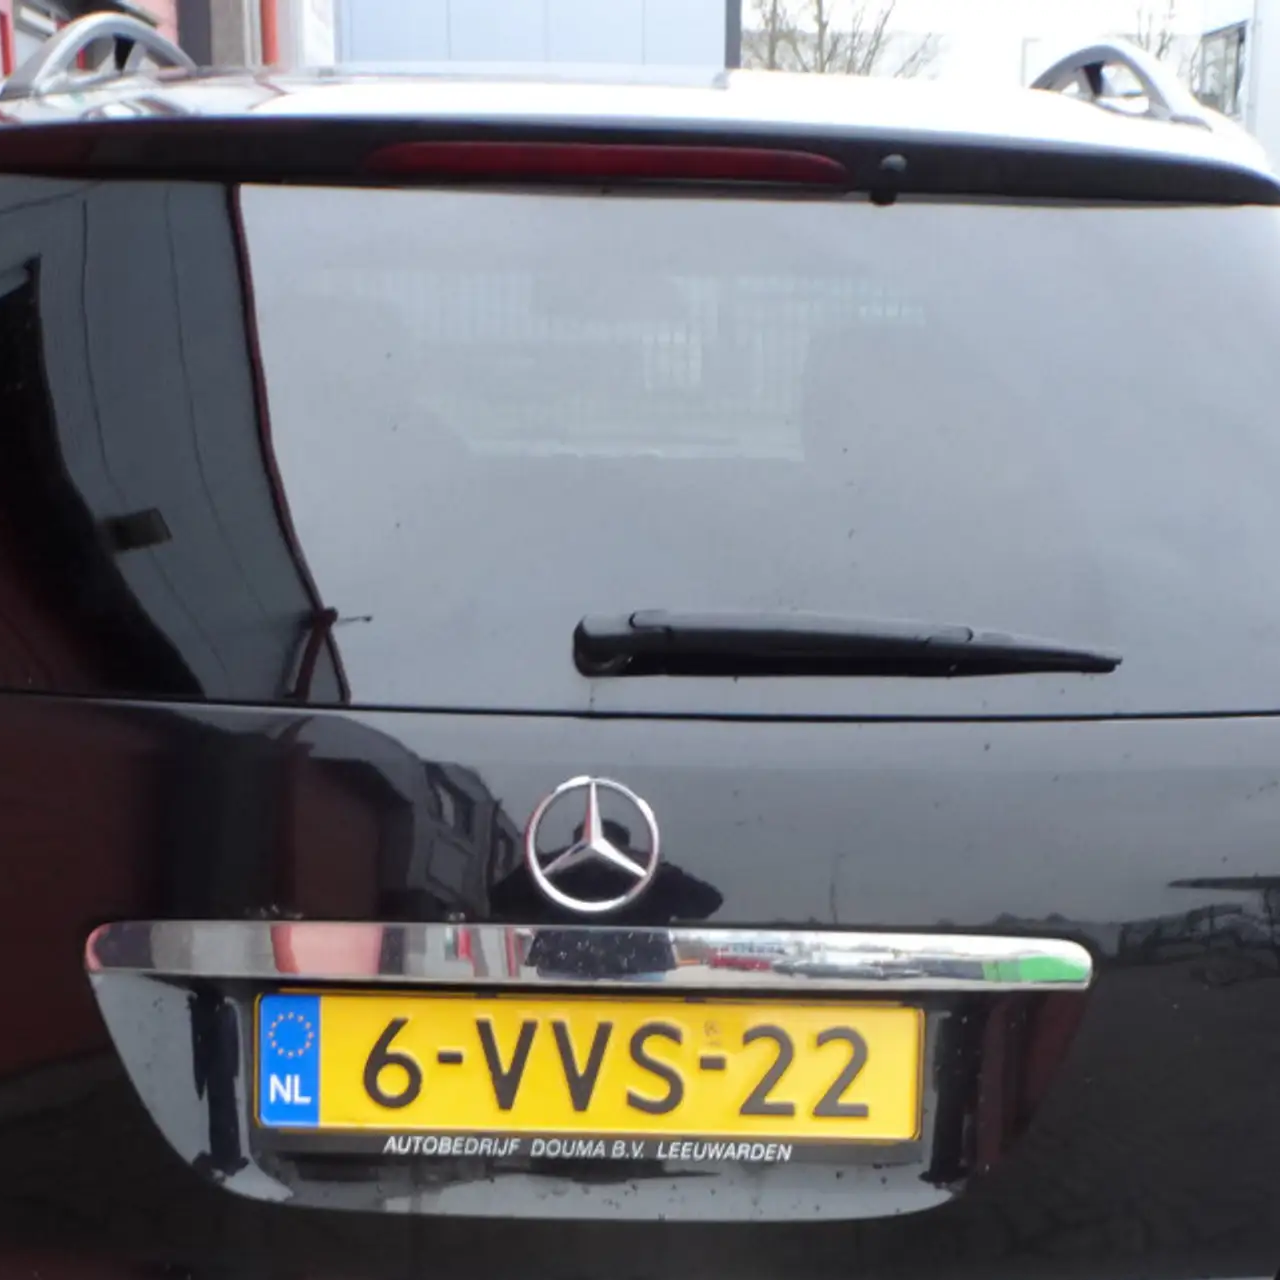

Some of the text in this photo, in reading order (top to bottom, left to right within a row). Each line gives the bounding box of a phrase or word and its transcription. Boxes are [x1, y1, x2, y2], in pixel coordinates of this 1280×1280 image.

[361, 1016, 870, 1118] 6-VVS-22
[269, 1073, 312, 1105] NL
[382, 1135, 793, 1162] AUTOBEDRIJF DOUMA B.V. LEEUWARDEN
